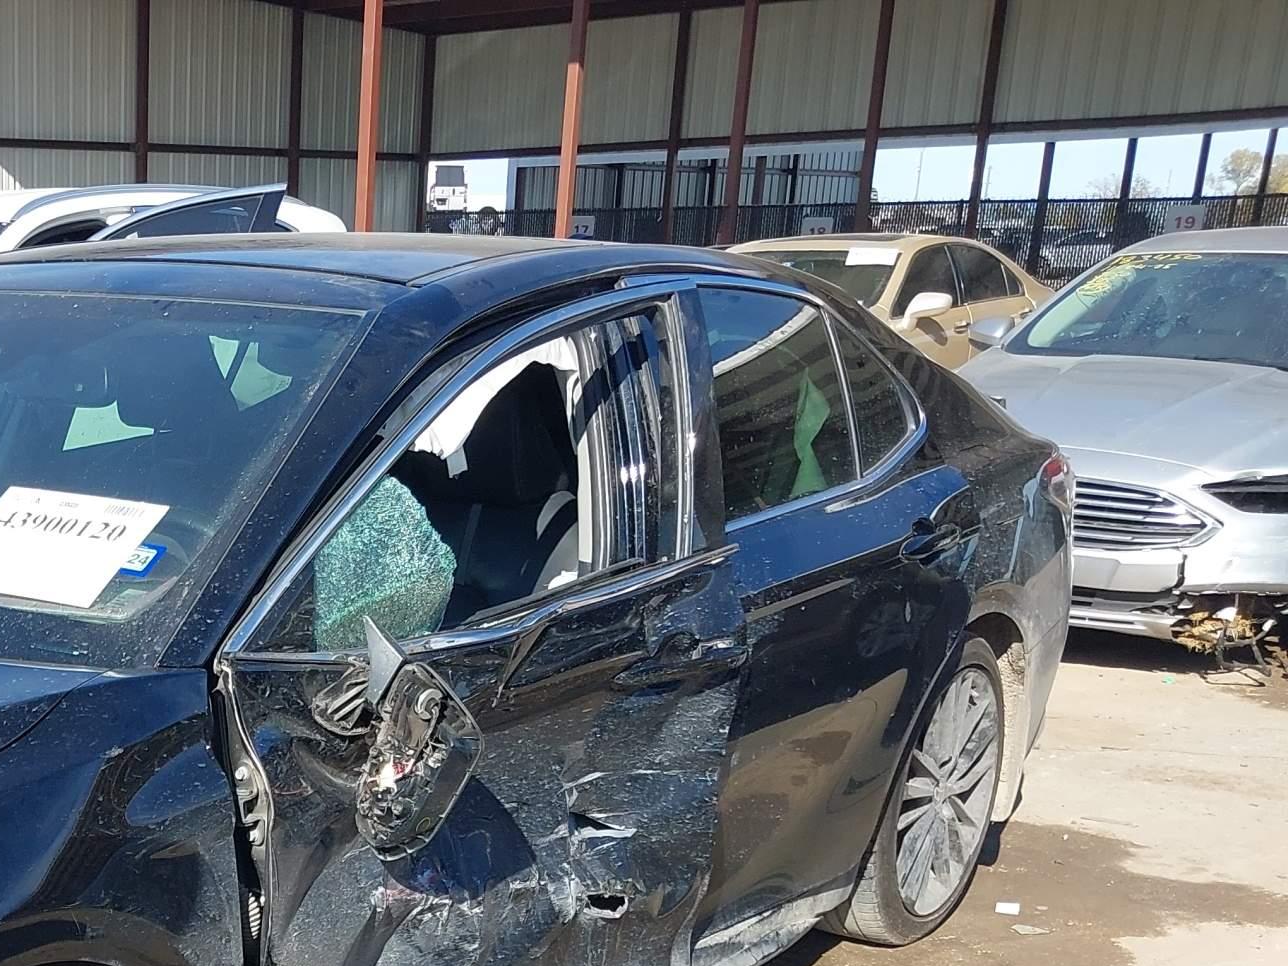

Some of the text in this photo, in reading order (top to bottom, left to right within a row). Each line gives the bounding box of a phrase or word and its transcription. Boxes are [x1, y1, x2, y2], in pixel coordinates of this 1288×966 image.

[574, 224, 589, 234] 17
[1175, 215, 1196, 229] 19
[0, 510, 128, 541] 43900120
